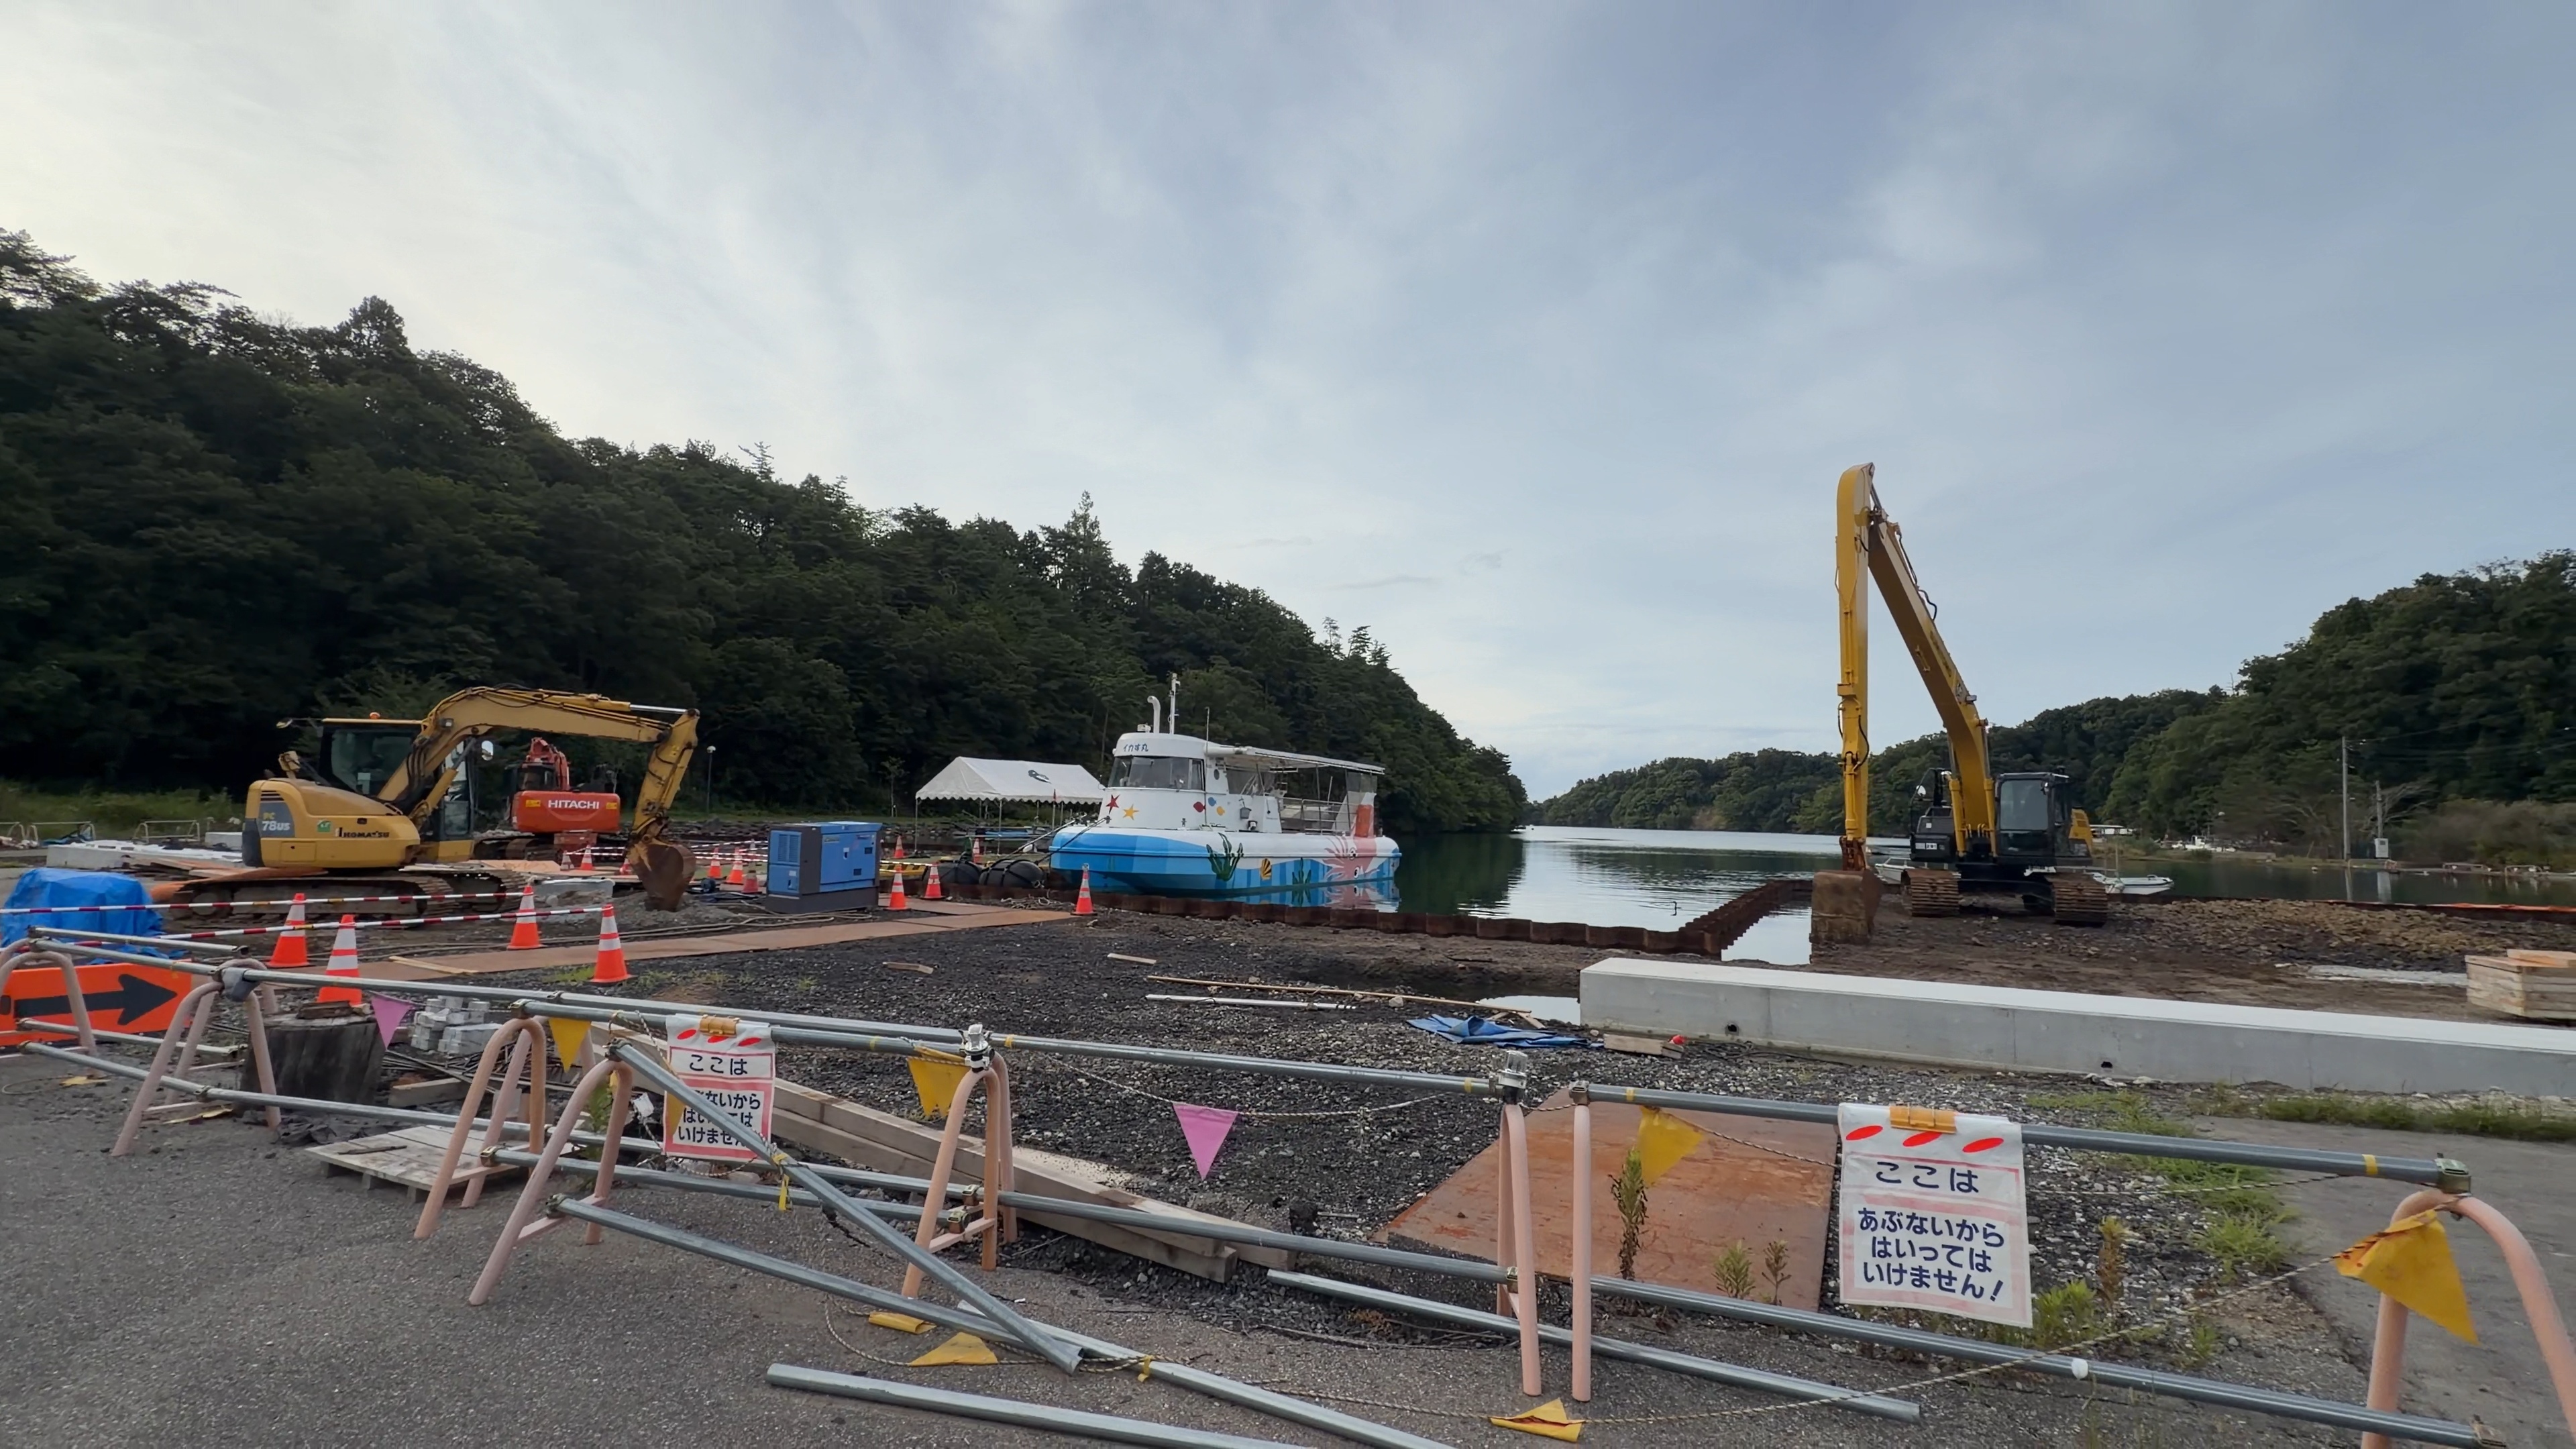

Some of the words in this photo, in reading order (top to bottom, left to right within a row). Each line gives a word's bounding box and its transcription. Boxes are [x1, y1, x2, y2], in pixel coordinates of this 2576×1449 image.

[548, 800, 600, 809] HITACHI
[690, 1054, 748, 1075] ここは
[1876, 1161, 1980, 1193] ここは
[1858, 1207, 2005, 1248] あぶないから
[1871, 1236, 1992, 1273] はいっては
[1863, 1262, 2004, 1302] いけません!
